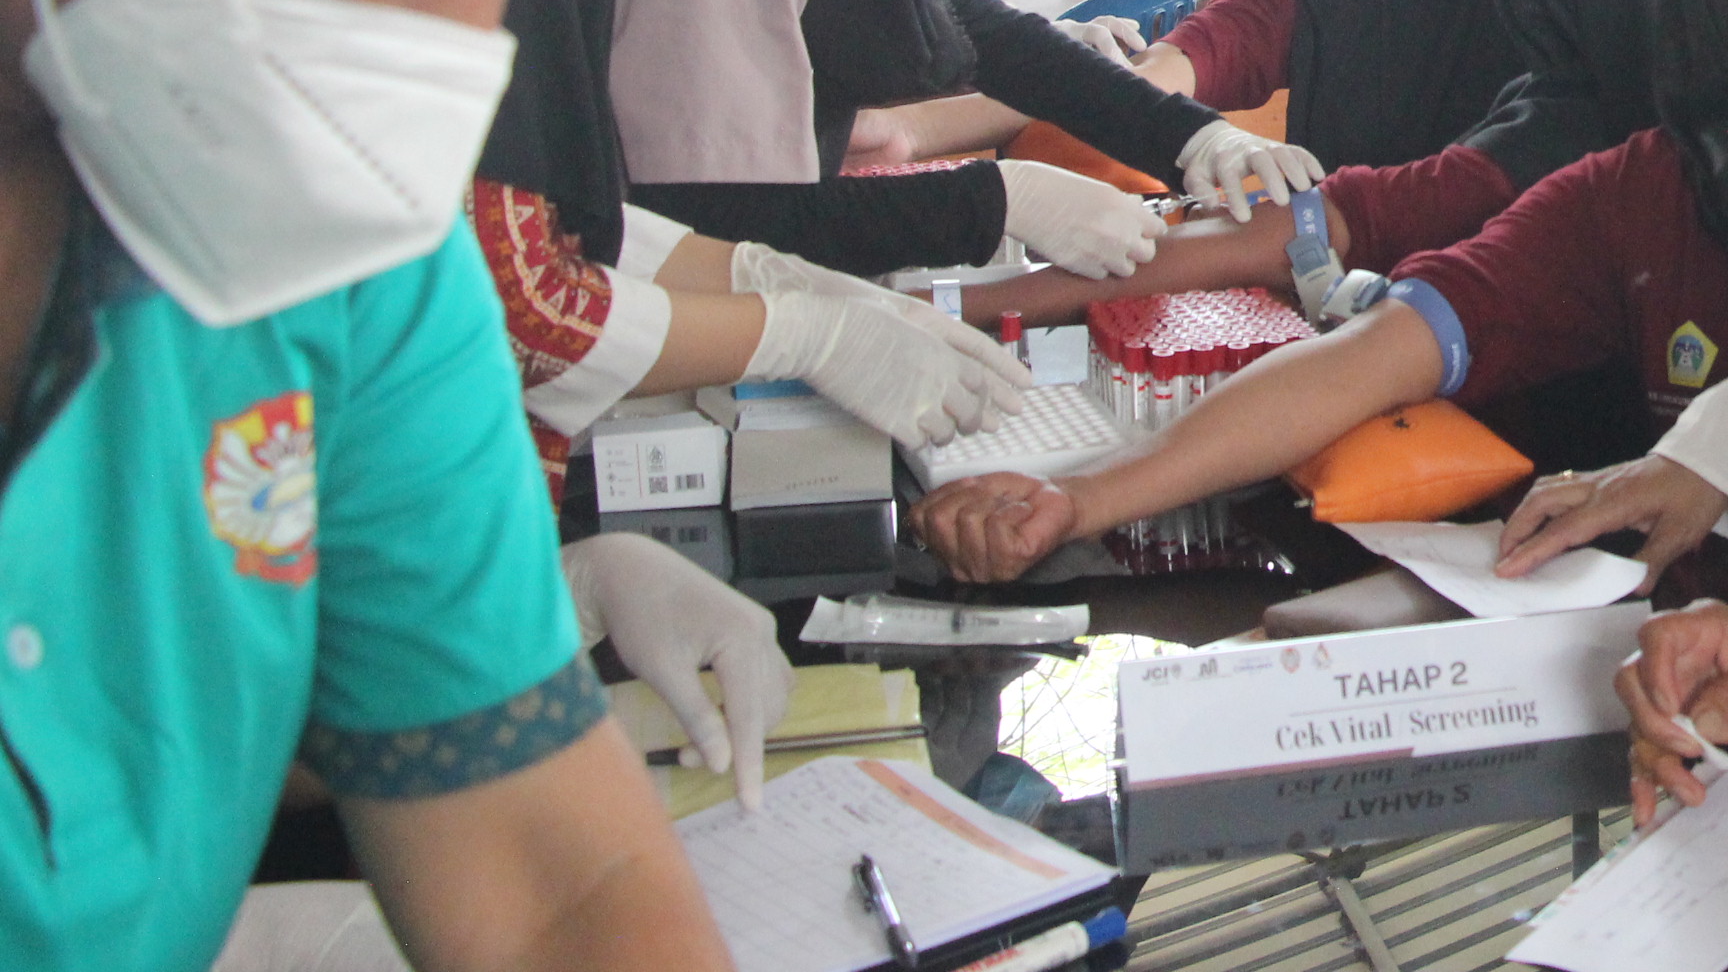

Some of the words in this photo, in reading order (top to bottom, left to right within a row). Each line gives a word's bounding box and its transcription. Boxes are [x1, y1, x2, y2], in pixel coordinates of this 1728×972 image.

[1333, 665, 1442, 699] TAHAP
[1450, 661, 1469, 686] 2
[1275, 721, 1325, 751] Cek
[1329, 712, 1393, 745] Vital
[1408, 699, 1540, 735] Screening
